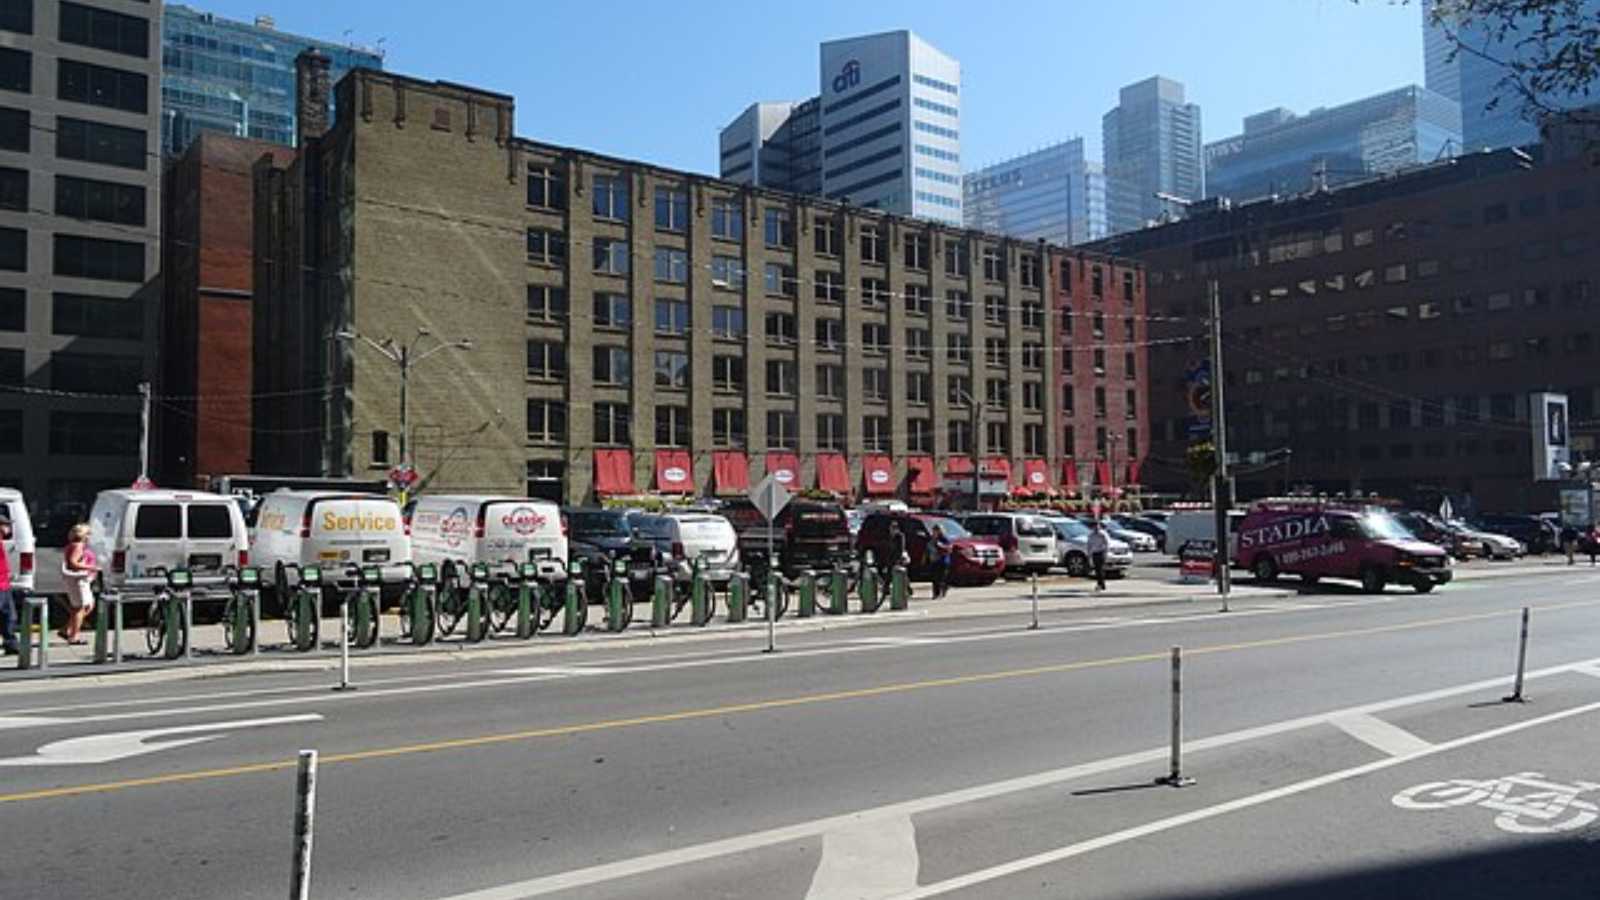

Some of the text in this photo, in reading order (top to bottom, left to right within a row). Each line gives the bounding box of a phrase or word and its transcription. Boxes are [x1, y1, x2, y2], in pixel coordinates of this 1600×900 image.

[323, 511, 396, 531] Service
[502, 514, 548, 526] CLASSIC
[1242, 517, 1330, 548] STADIA
